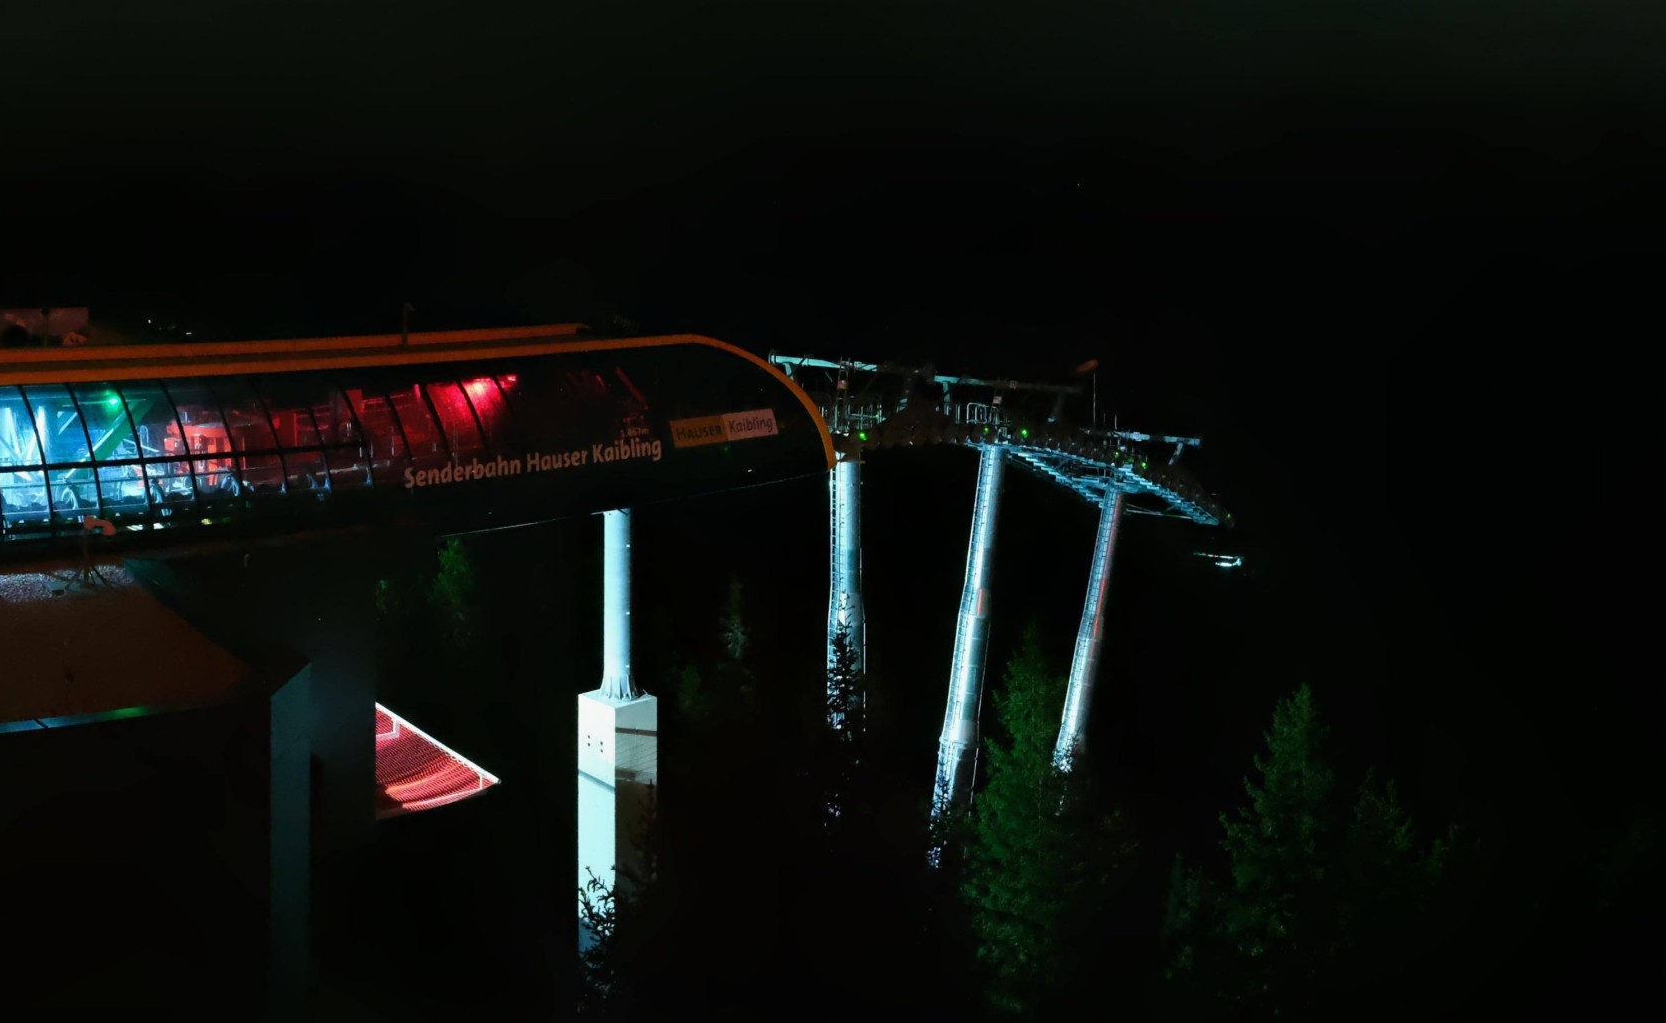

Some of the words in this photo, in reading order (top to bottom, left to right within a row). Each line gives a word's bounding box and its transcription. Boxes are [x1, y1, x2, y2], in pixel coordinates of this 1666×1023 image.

[676, 424, 722, 441] HAUSER
[728, 416, 773, 433] Kaibling
[404, 454, 521, 489] Senderbahn
[526, 447, 588, 474] Hauser
[592, 438, 662, 464] Kaibling
